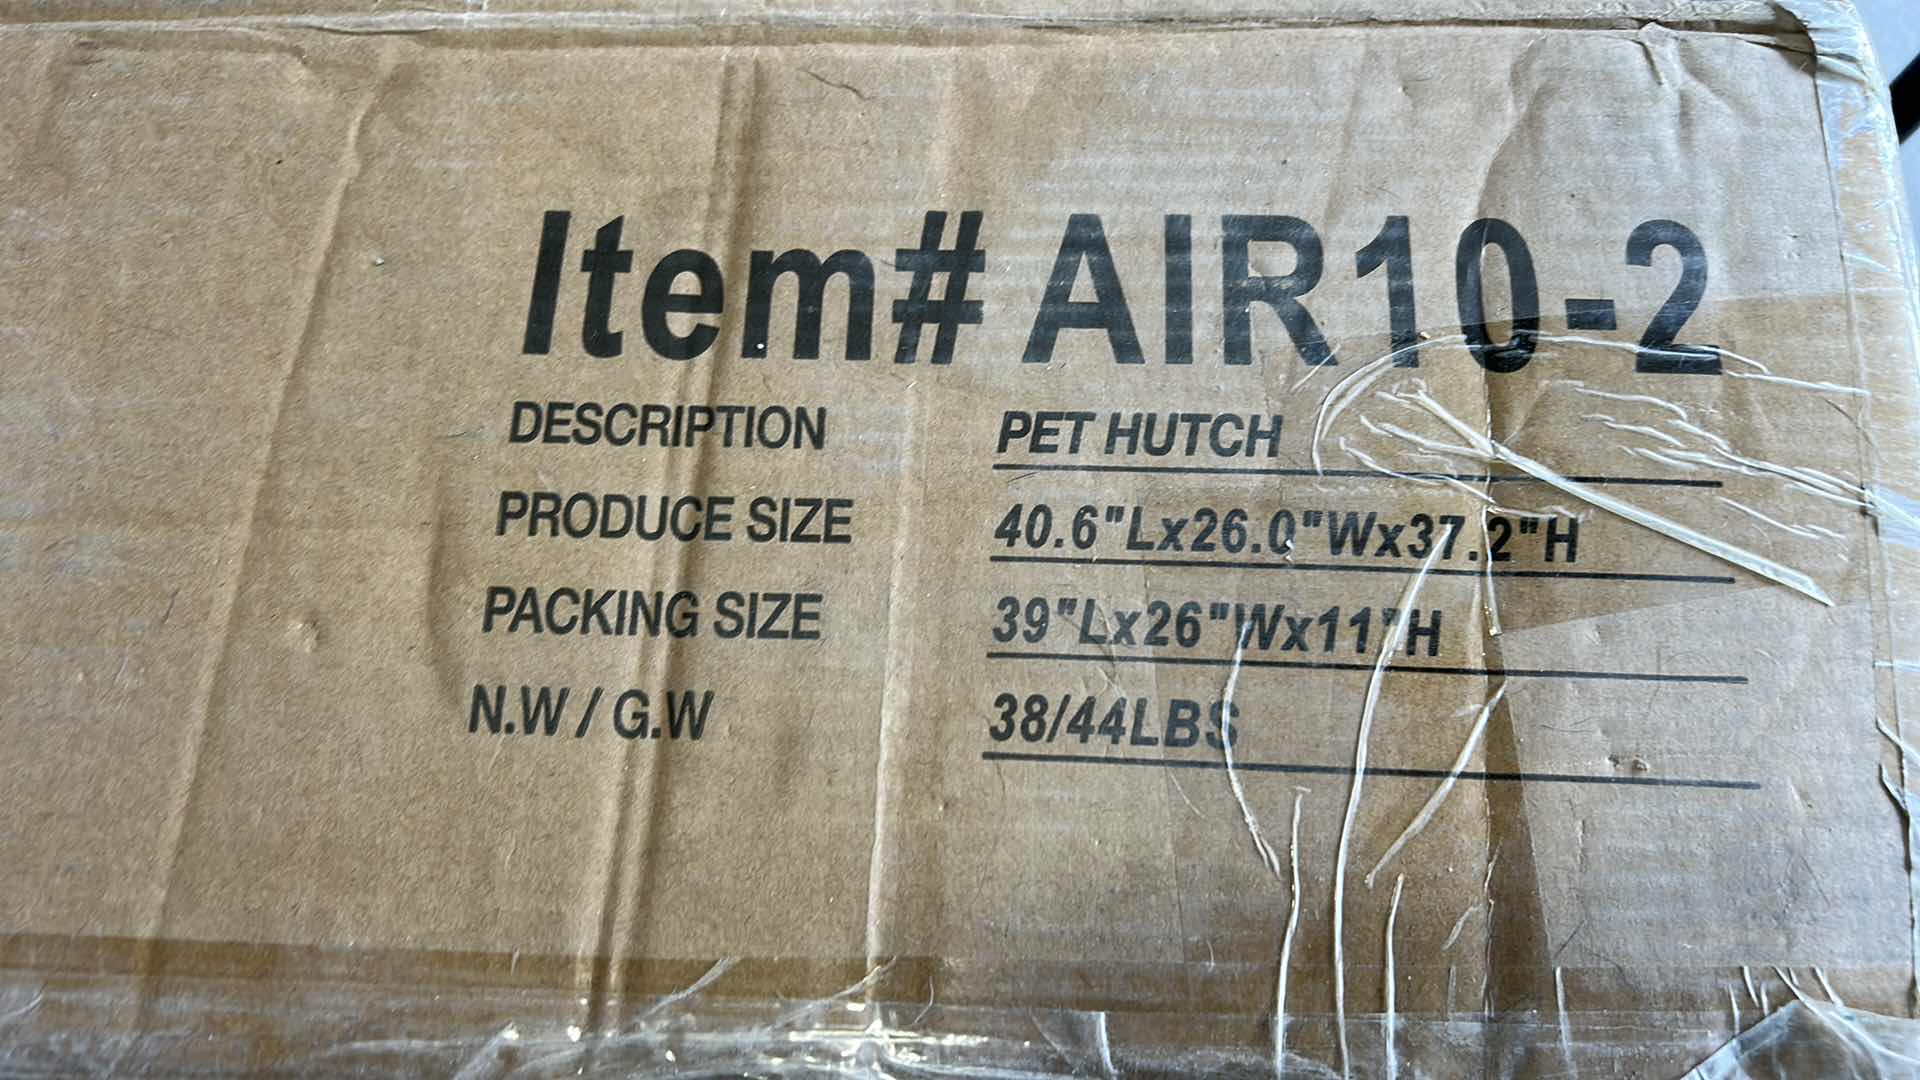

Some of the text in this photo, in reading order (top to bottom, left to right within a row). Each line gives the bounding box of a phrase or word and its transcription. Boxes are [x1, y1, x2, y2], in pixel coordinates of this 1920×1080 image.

[522, 209, 1723, 375] Item# AIR10-2
[509, 401, 827, 449] DESCRIPTION
[997, 411, 1283, 457] PET HUTCH
[496, 491, 853, 544] PRODUCE SIZE
[994, 503, 1579, 563] 40.6"Lx26.0"Wx37.2"H
[482, 586, 823, 639] PACKING SIZE
[992, 597, 1442, 657] 39"Lx26"Wx11"H
[468, 684, 715, 739] N.W / G.W
[989, 693, 1241, 750] 38/44LBS
